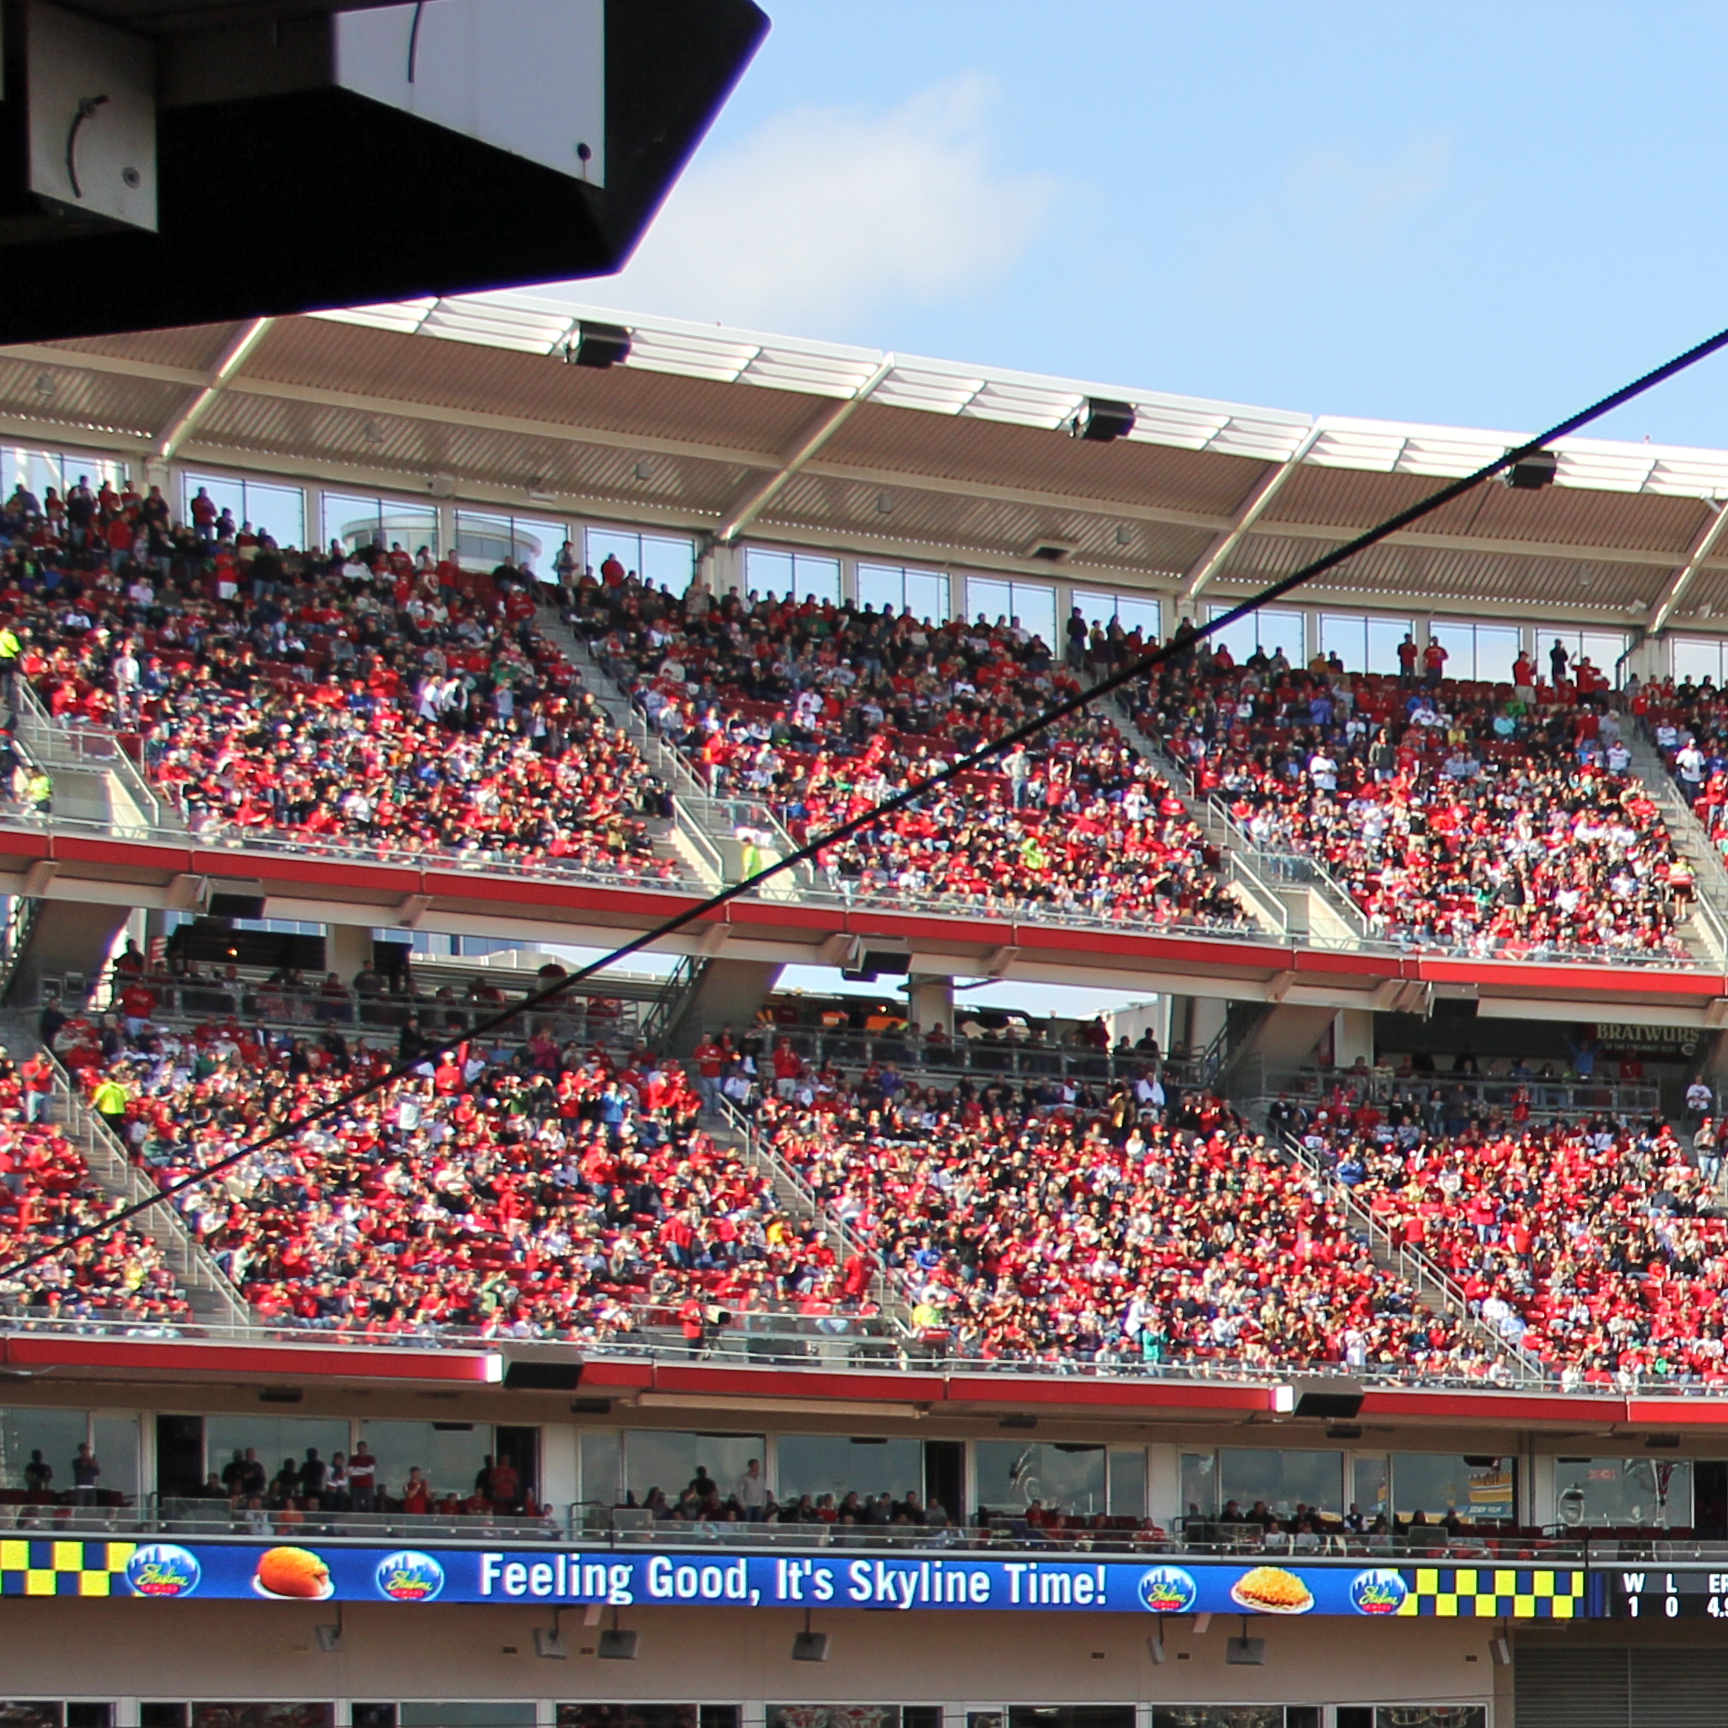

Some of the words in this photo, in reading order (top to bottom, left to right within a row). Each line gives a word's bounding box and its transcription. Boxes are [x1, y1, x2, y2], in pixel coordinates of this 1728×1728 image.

[482, 1553, 633, 1605] Feeling
[648, 1556, 760, 1607] Good,
[777, 1558, 835, 1601] It's
[848, 1560, 988, 1609] Skyline
[1004, 1562, 1106, 1604] Time!
[1623, 1573, 1645, 1593] W
[1666, 1574, 1678, 1593] L
[1628, 1596, 1638, 1617] 1
[1665, 1597, 1678, 1618] 0
